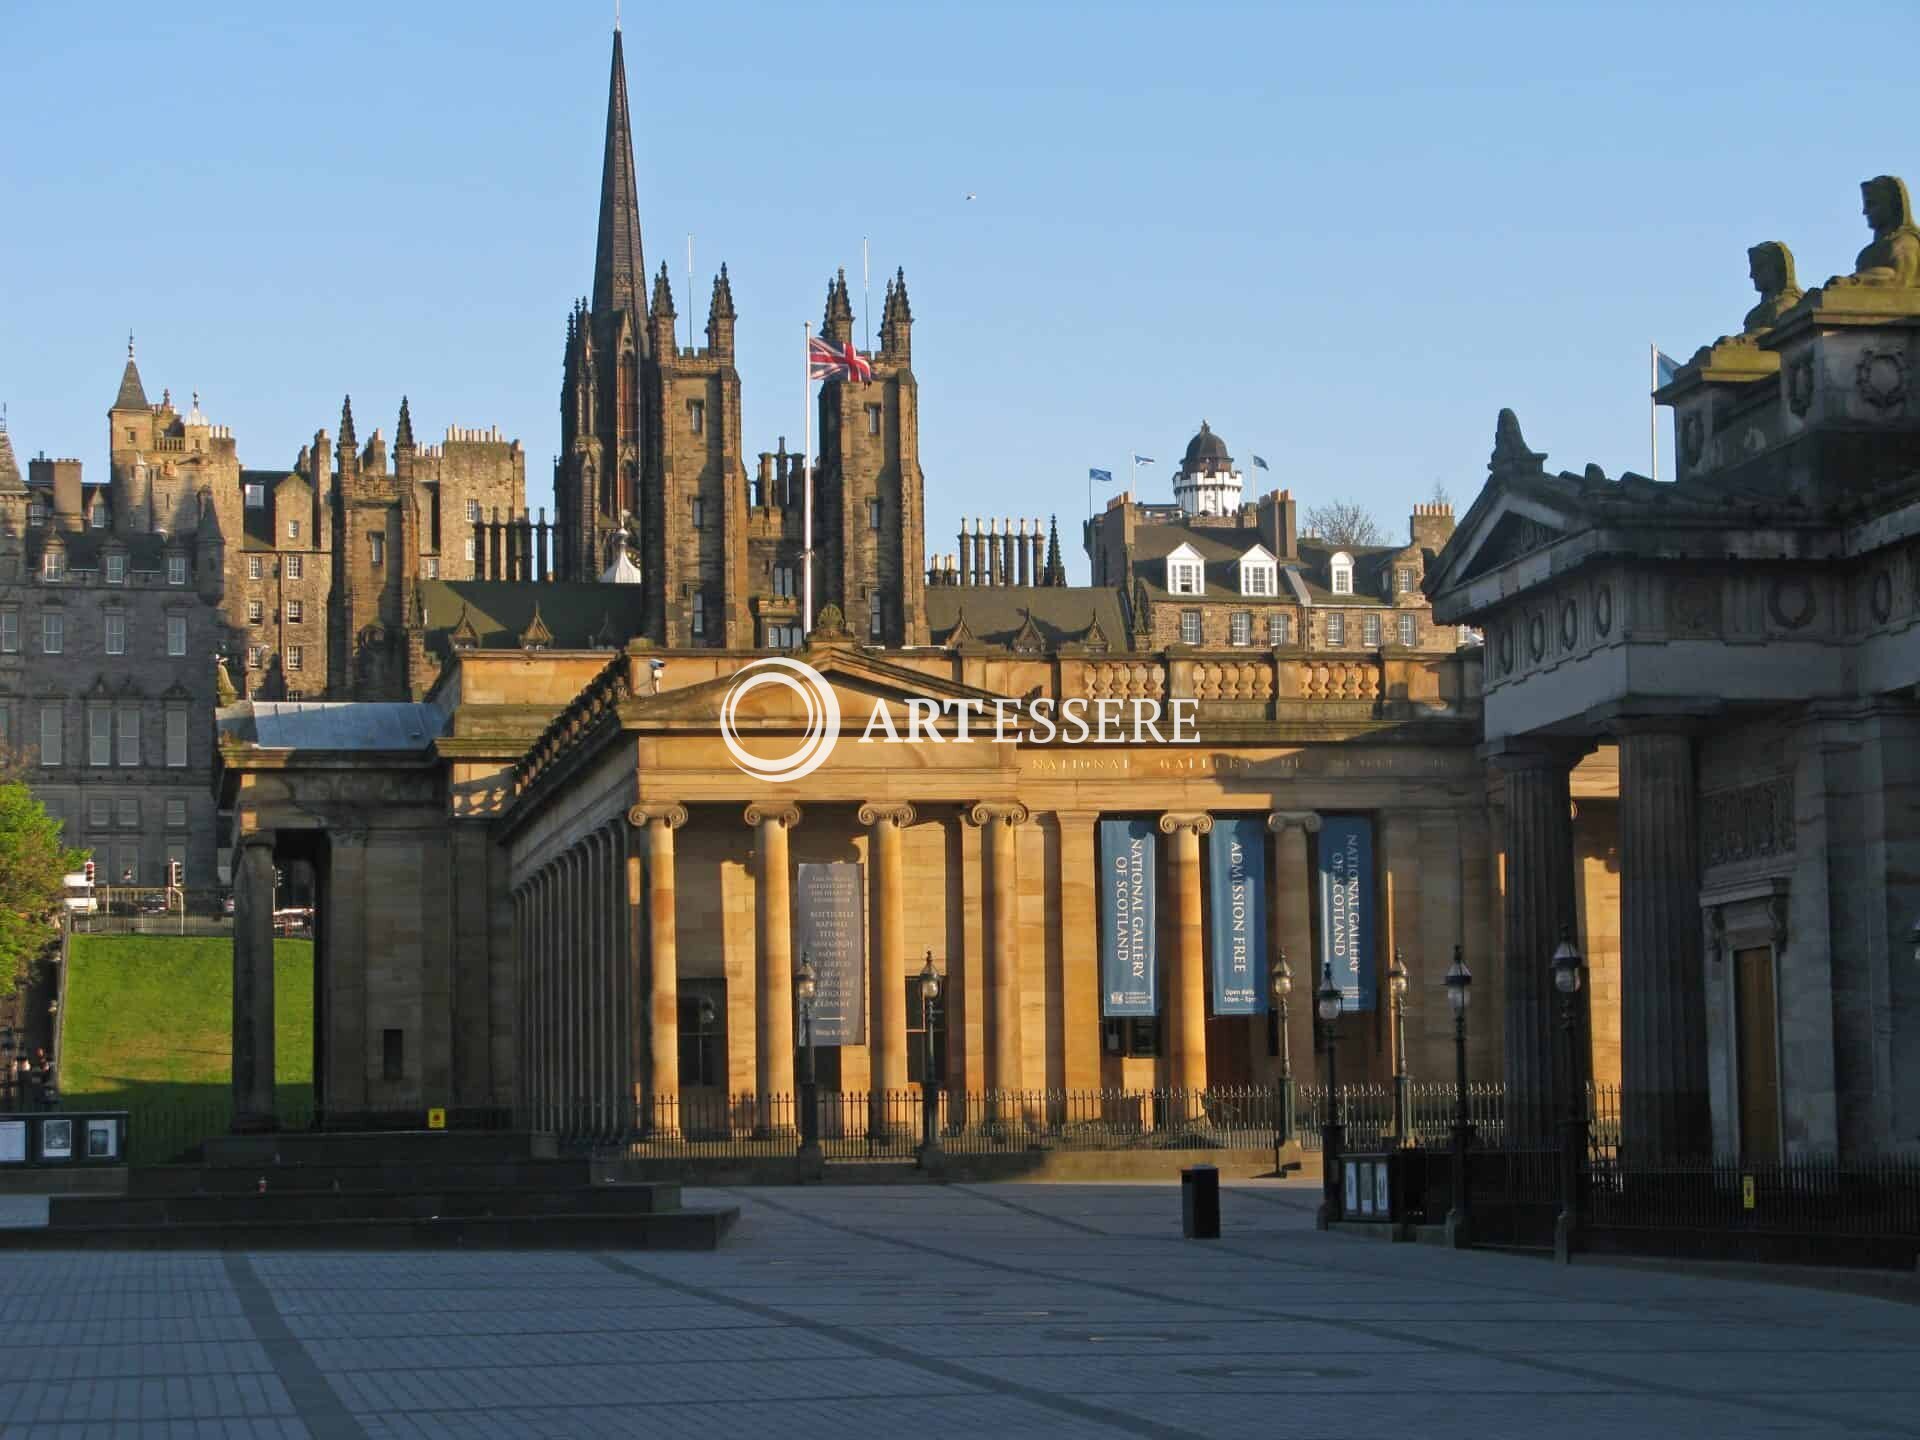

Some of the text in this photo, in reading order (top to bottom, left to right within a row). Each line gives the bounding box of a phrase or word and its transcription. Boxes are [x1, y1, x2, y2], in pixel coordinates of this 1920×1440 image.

[1115, 856, 1129, 961] OF SCOTLAND
[1128, 839, 1144, 913] NATIONAL
[1230, 841, 1247, 973] ADMISSION FREE
[1332, 852, 1345, 956] OF SCOTLAND
[1346, 834, 1360, 909] NATIONAL
[1131, 916, 1146, 979] GALLERY
[1348, 912, 1360, 973] GALLERY
